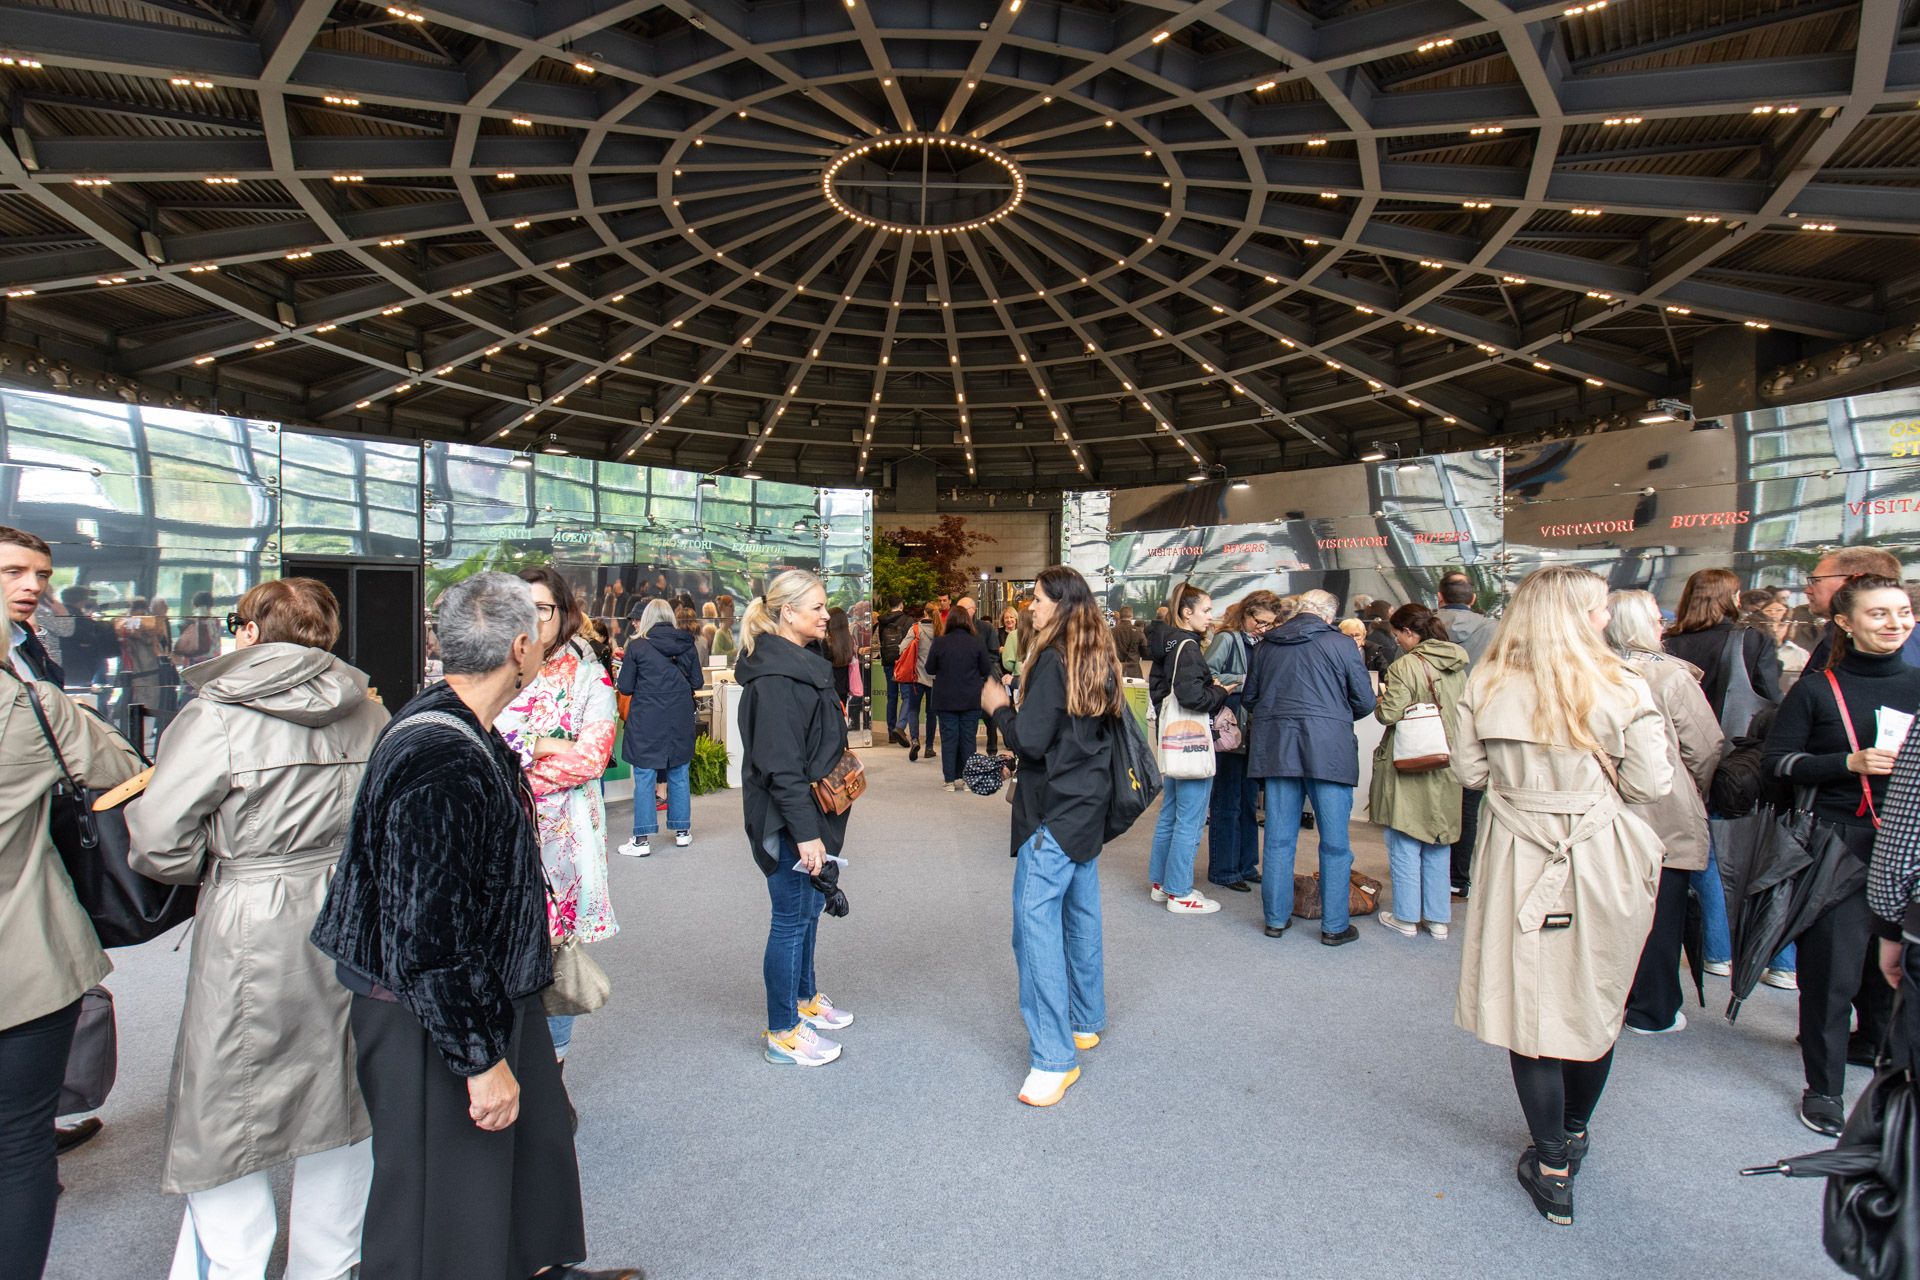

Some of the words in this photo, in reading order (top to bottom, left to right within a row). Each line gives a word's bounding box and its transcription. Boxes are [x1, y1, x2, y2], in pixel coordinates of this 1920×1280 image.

[478, 526, 532, 540] AGENTI
[1538, 519, 1636, 538] VISITATORI
[1669, 510, 1751, 529] BUYERS
[648, 536, 713, 550] ESPOSITORI
[731, 541, 788, 555] EXHIBITORS
[1316, 535, 1389, 550] VISITATORI
[1414, 530, 1471, 545] BUYERS
[1147, 545, 1204, 558] VISITATORI
[1221, 542, 1265, 555] BUYERS
